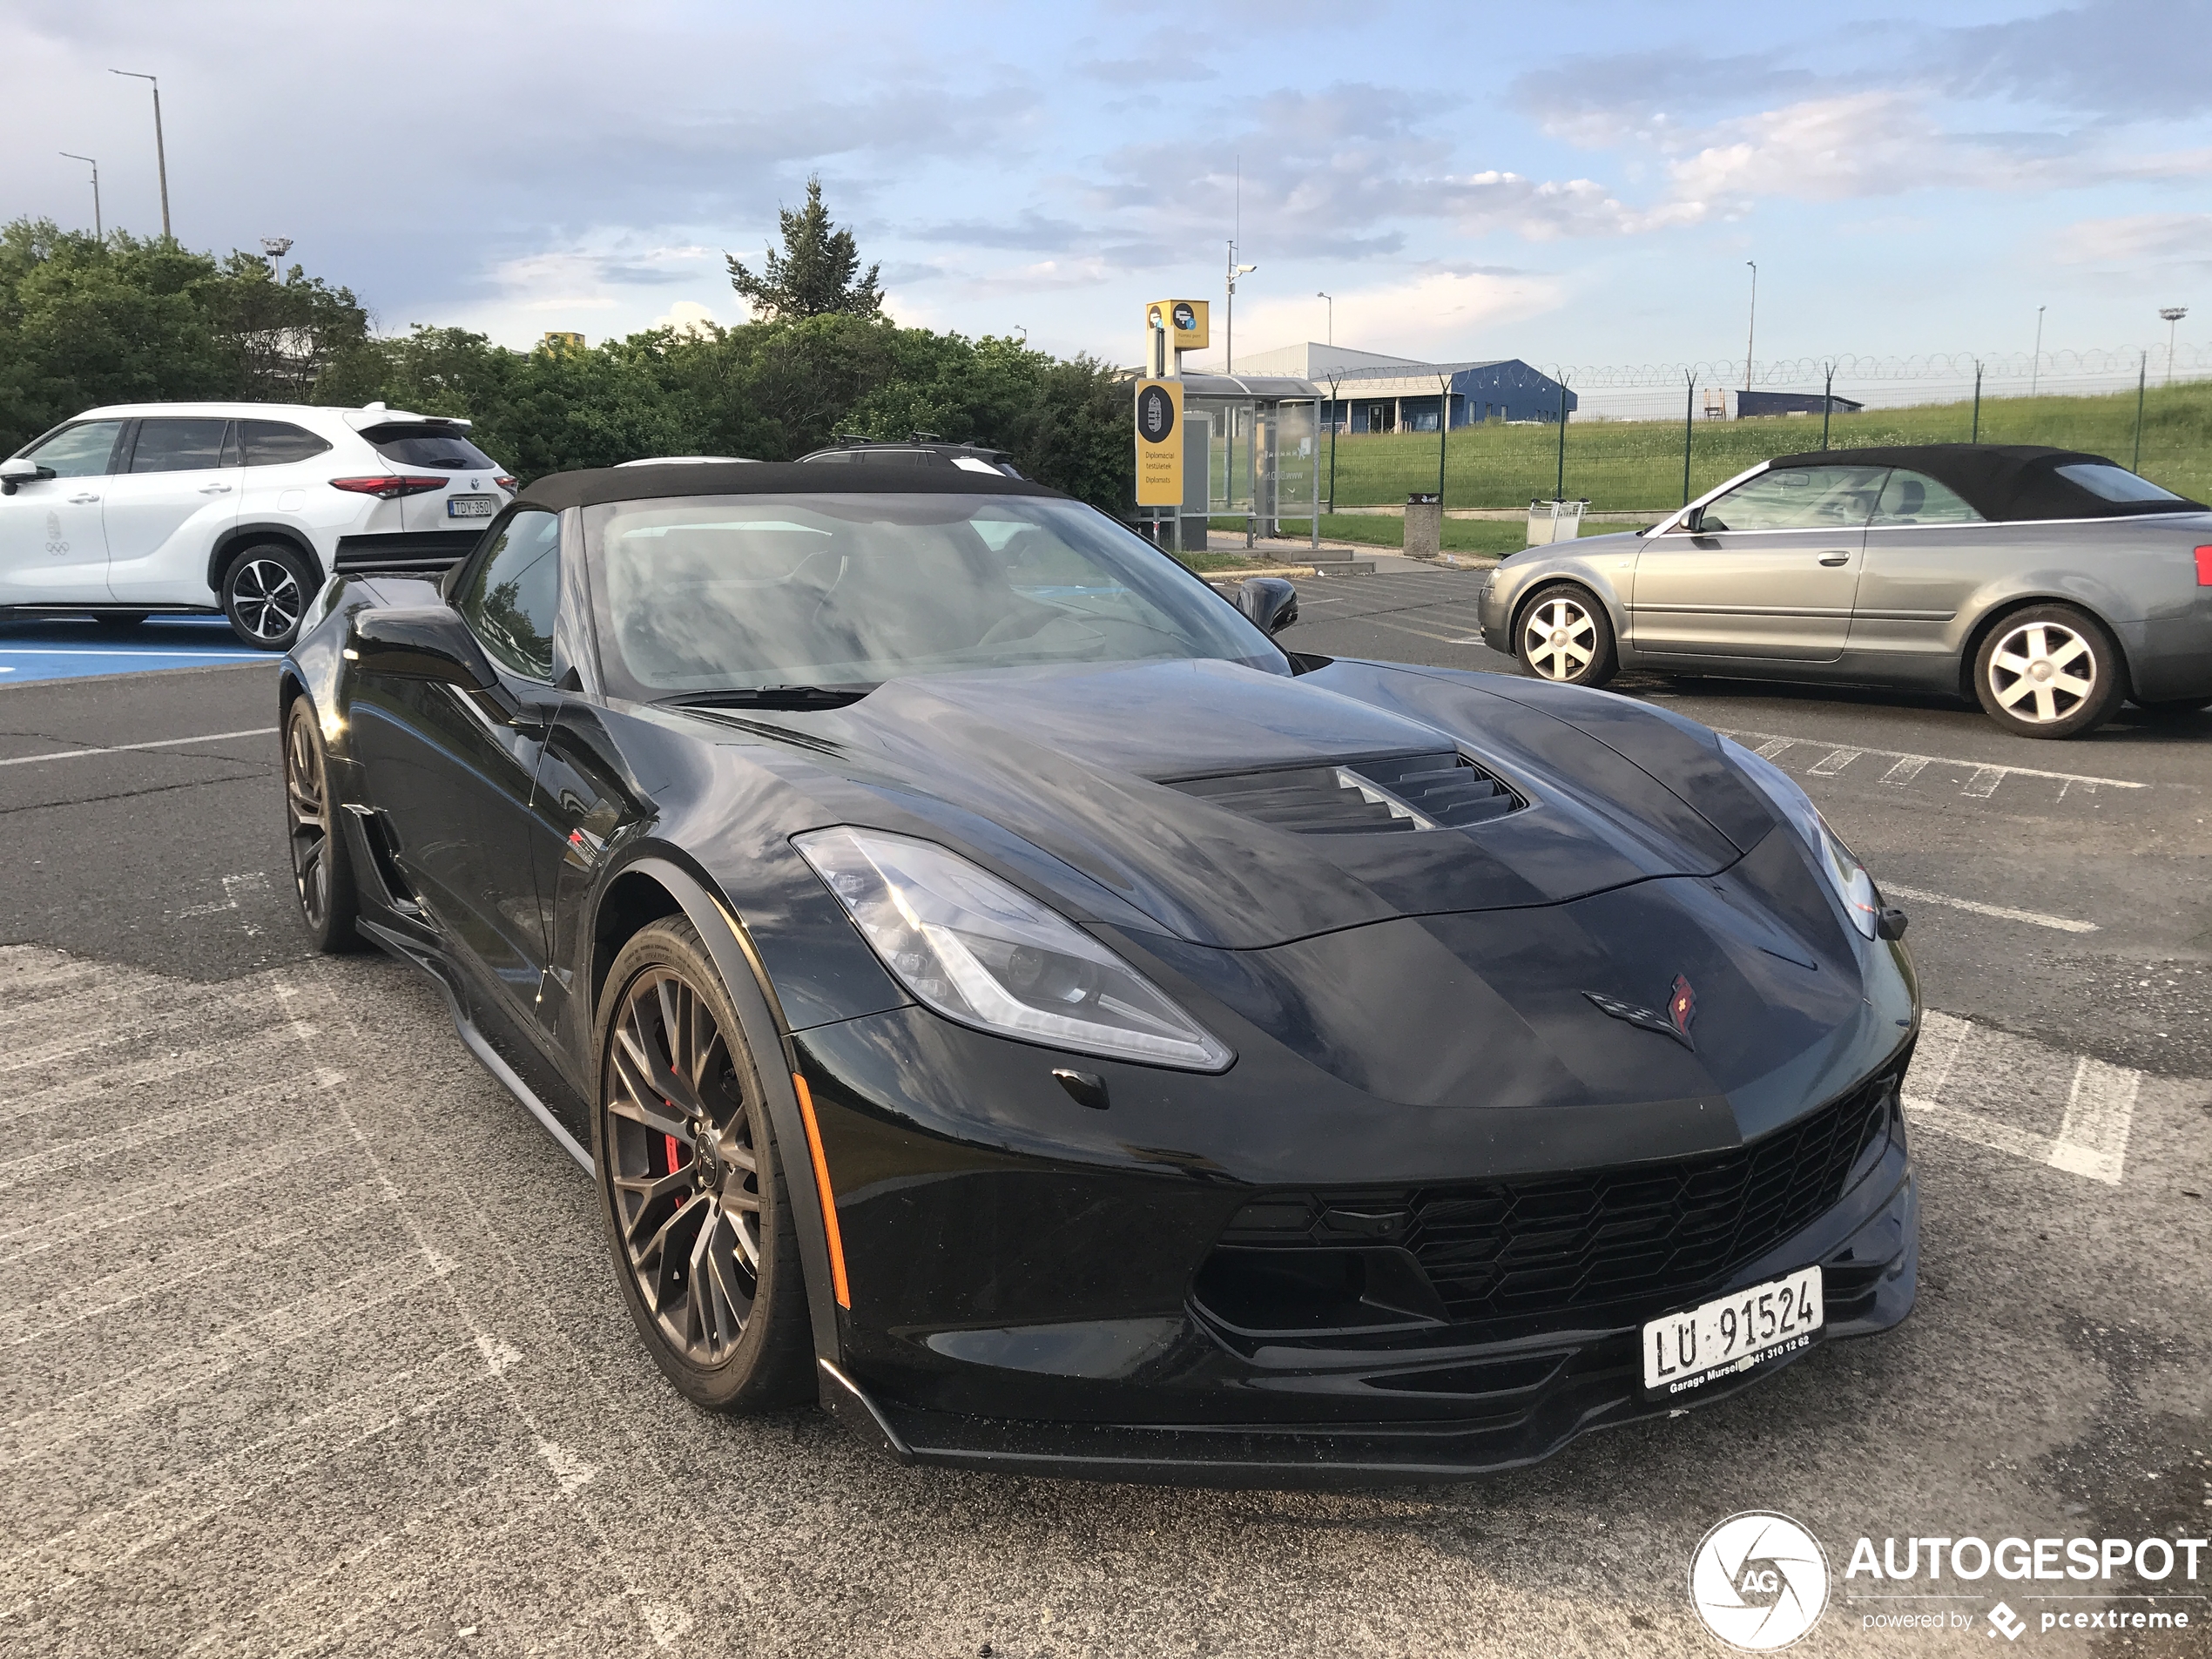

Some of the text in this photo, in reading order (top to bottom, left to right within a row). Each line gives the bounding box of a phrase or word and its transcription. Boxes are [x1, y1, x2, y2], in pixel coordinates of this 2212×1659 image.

[1145, 476, 1171, 485] Diplomats
[455, 502, 489, 514] TDY-350
[1720, 1280, 1813, 1355] 91524
[1669, 1374, 1705, 1393] Garage
[1767, 1345, 1784, 1359] 310
[1785, 1340, 1797, 1352] 12
[1798, 1335, 1810, 1347] 62
